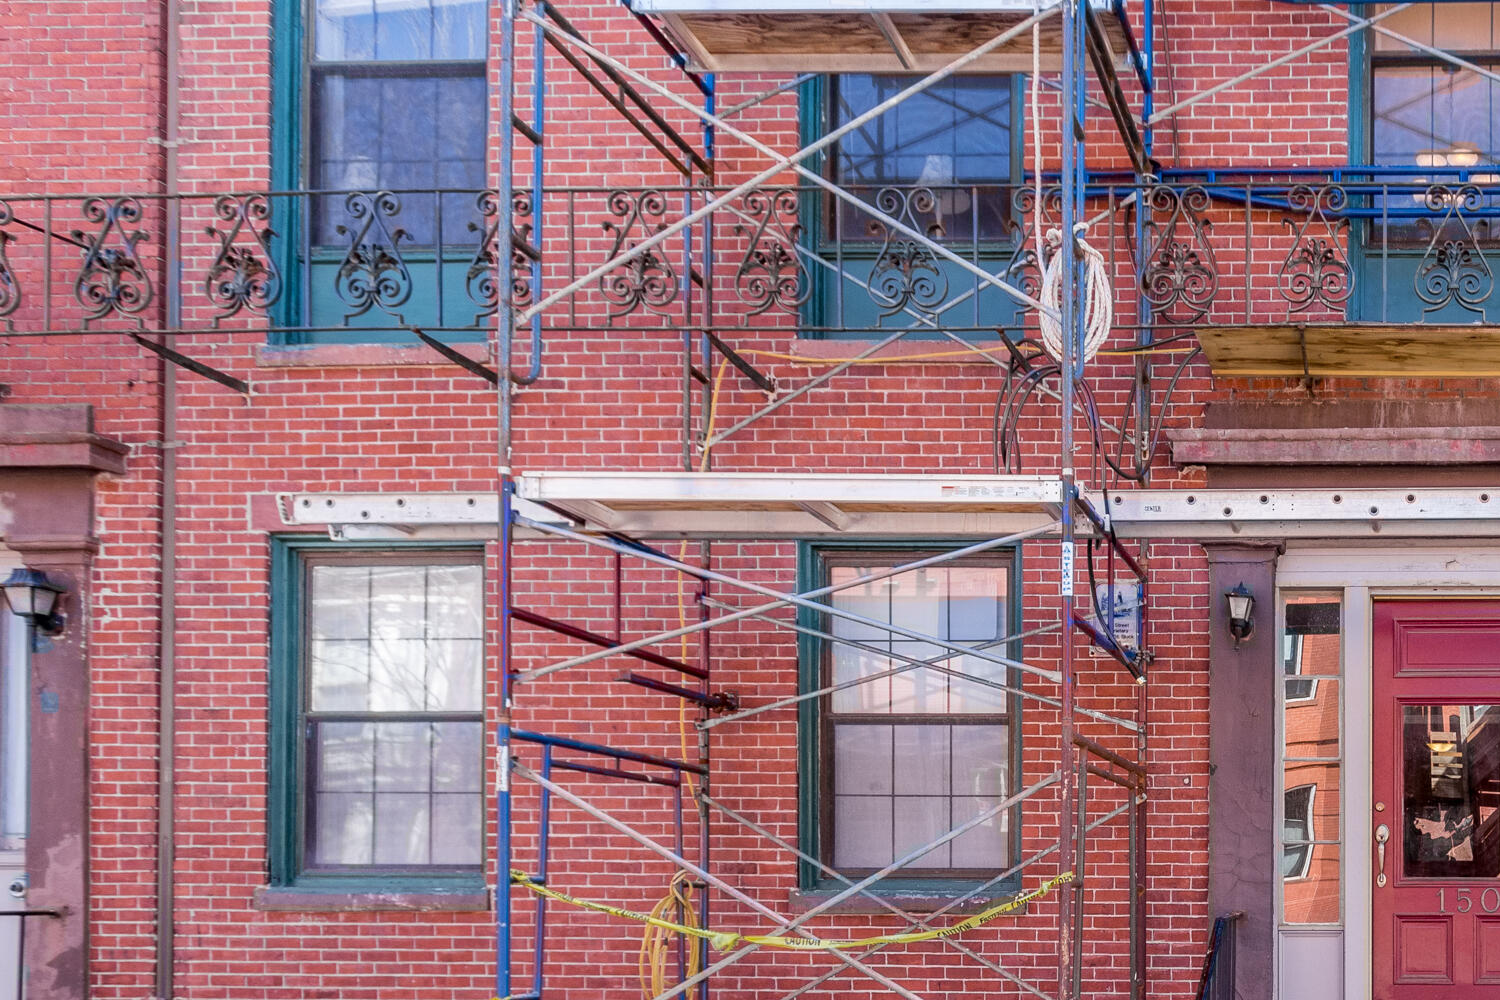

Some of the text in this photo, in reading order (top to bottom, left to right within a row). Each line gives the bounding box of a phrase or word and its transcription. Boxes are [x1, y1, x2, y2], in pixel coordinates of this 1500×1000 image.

[1436, 887, 1500, 914] 150
[936, 922, 973, 936] CAUTION
[784, 937, 821, 947] CAUTION
